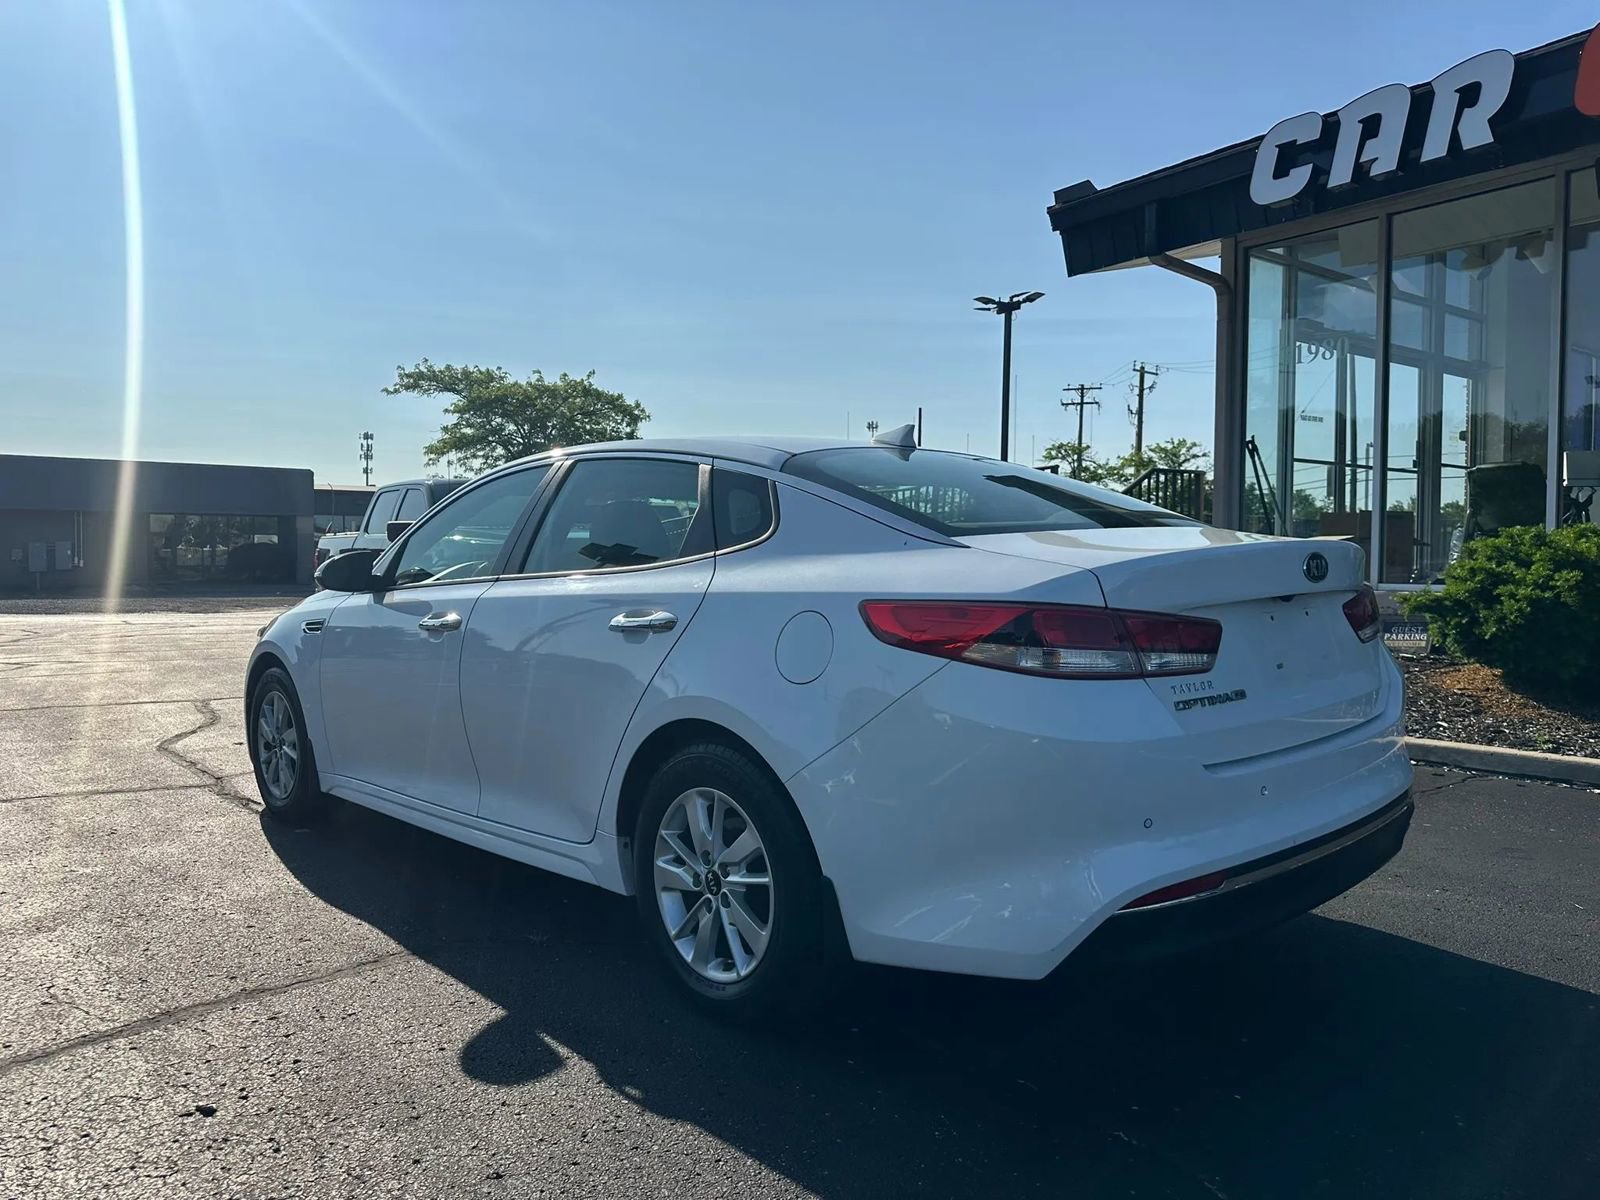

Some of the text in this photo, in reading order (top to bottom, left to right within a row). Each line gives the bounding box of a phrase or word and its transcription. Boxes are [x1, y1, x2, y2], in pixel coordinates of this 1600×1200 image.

[1250, 49, 1515, 205] CAR
[1391, 626, 1424, 634] GUEST
[1384, 633, 1428, 641] PARKING
[1170, 680, 1214, 695] TAYLOR
